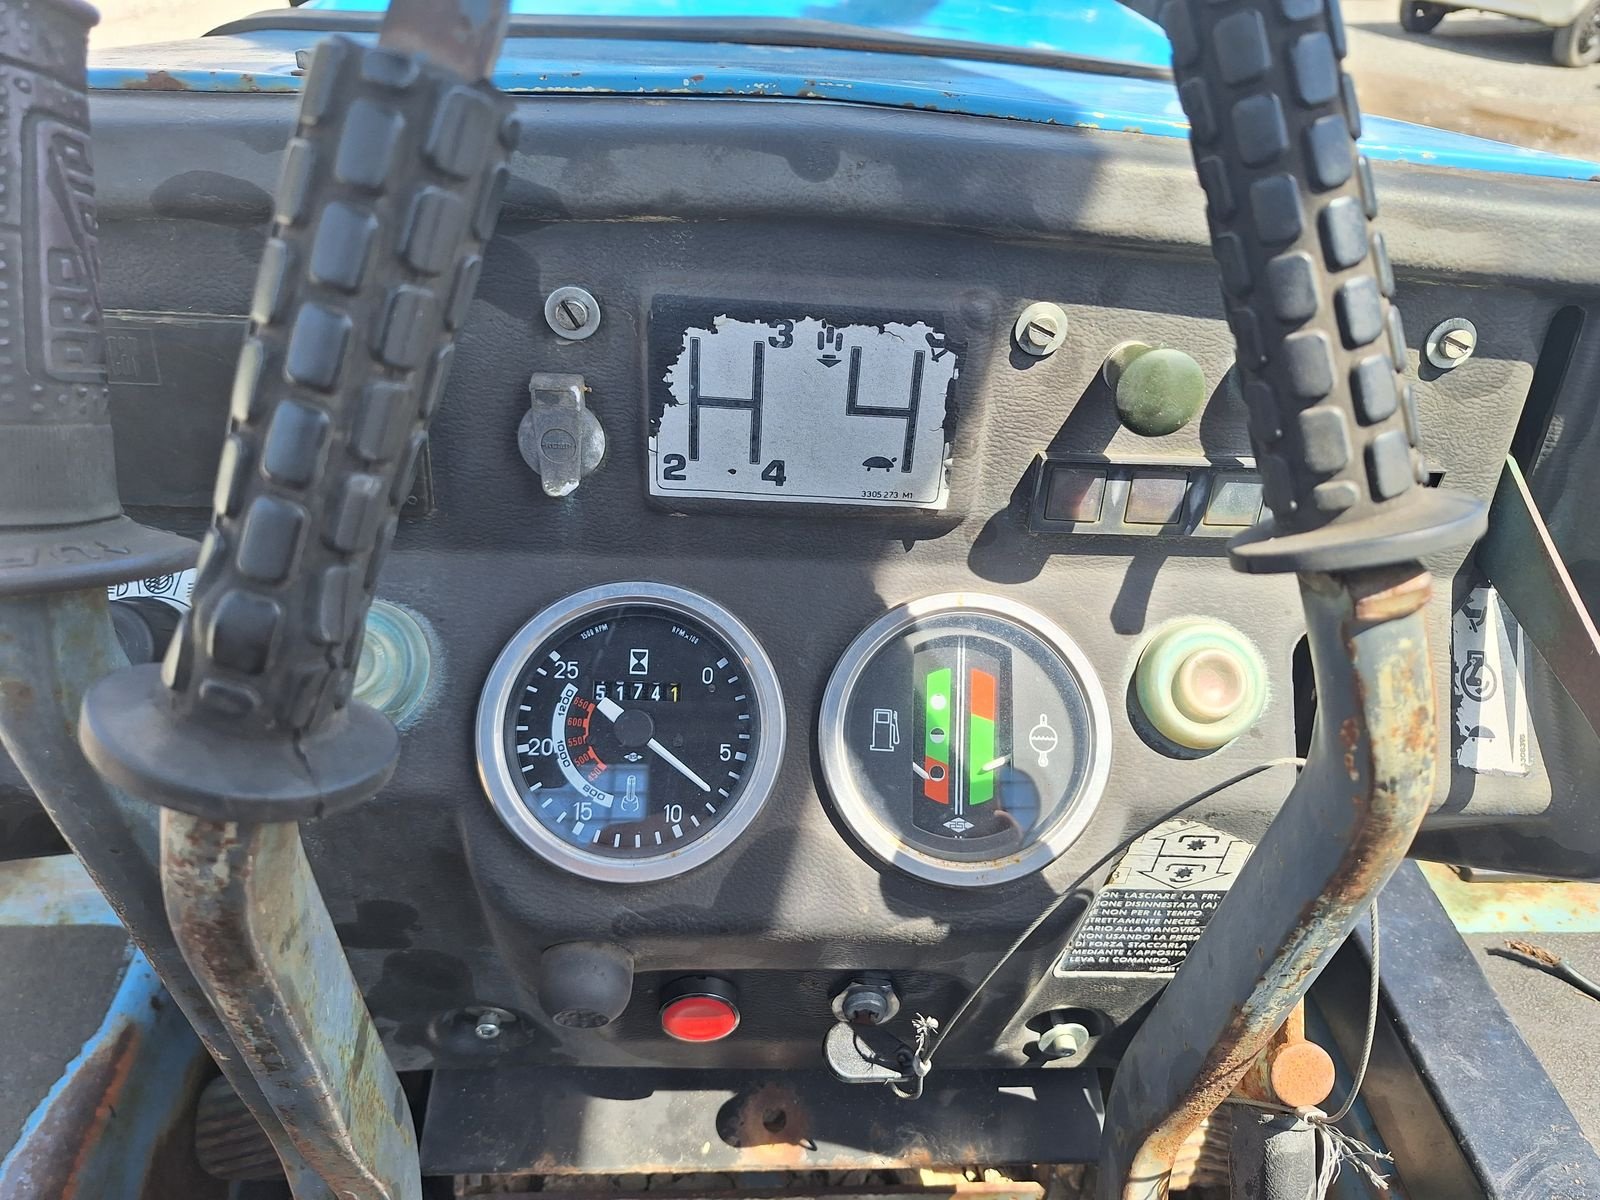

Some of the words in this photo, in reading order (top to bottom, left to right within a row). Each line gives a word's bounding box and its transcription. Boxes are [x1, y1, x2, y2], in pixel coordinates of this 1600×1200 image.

[768, 319, 794, 348] 3
[663, 453, 687, 481] 2
[761, 460, 787, 486] 4
[554, 661, 579, 679] 25
[702, 666, 714, 684] 0
[558, 688, 574, 716] 1200
[573, 696, 589, 710] 650
[567, 717, 582, 727] 600
[528, 738, 554, 756] 20
[568, 736, 583, 747] 550
[557, 740, 571, 768] 1000
[574, 753, 590, 767] 500
[719, 743, 731, 761] 5
[582, 784, 606, 801] 800
[573, 802, 593, 821] 15
[664, 804, 683, 823] 10
[1098, 891, 1119, 899] ON
[1124, 892, 1177, 900] LASCIARE
[1095, 900, 1123, 908] IONE
[1124, 900, 1199, 909] DISINNESTATA
[1101, 908, 1128, 916] NON
[1126, 949, 1187, 957] L'APPOSITA
[1127, 941, 1188, 949] STACCARLA
[1112, 956, 1171, 964] COMANDO.
